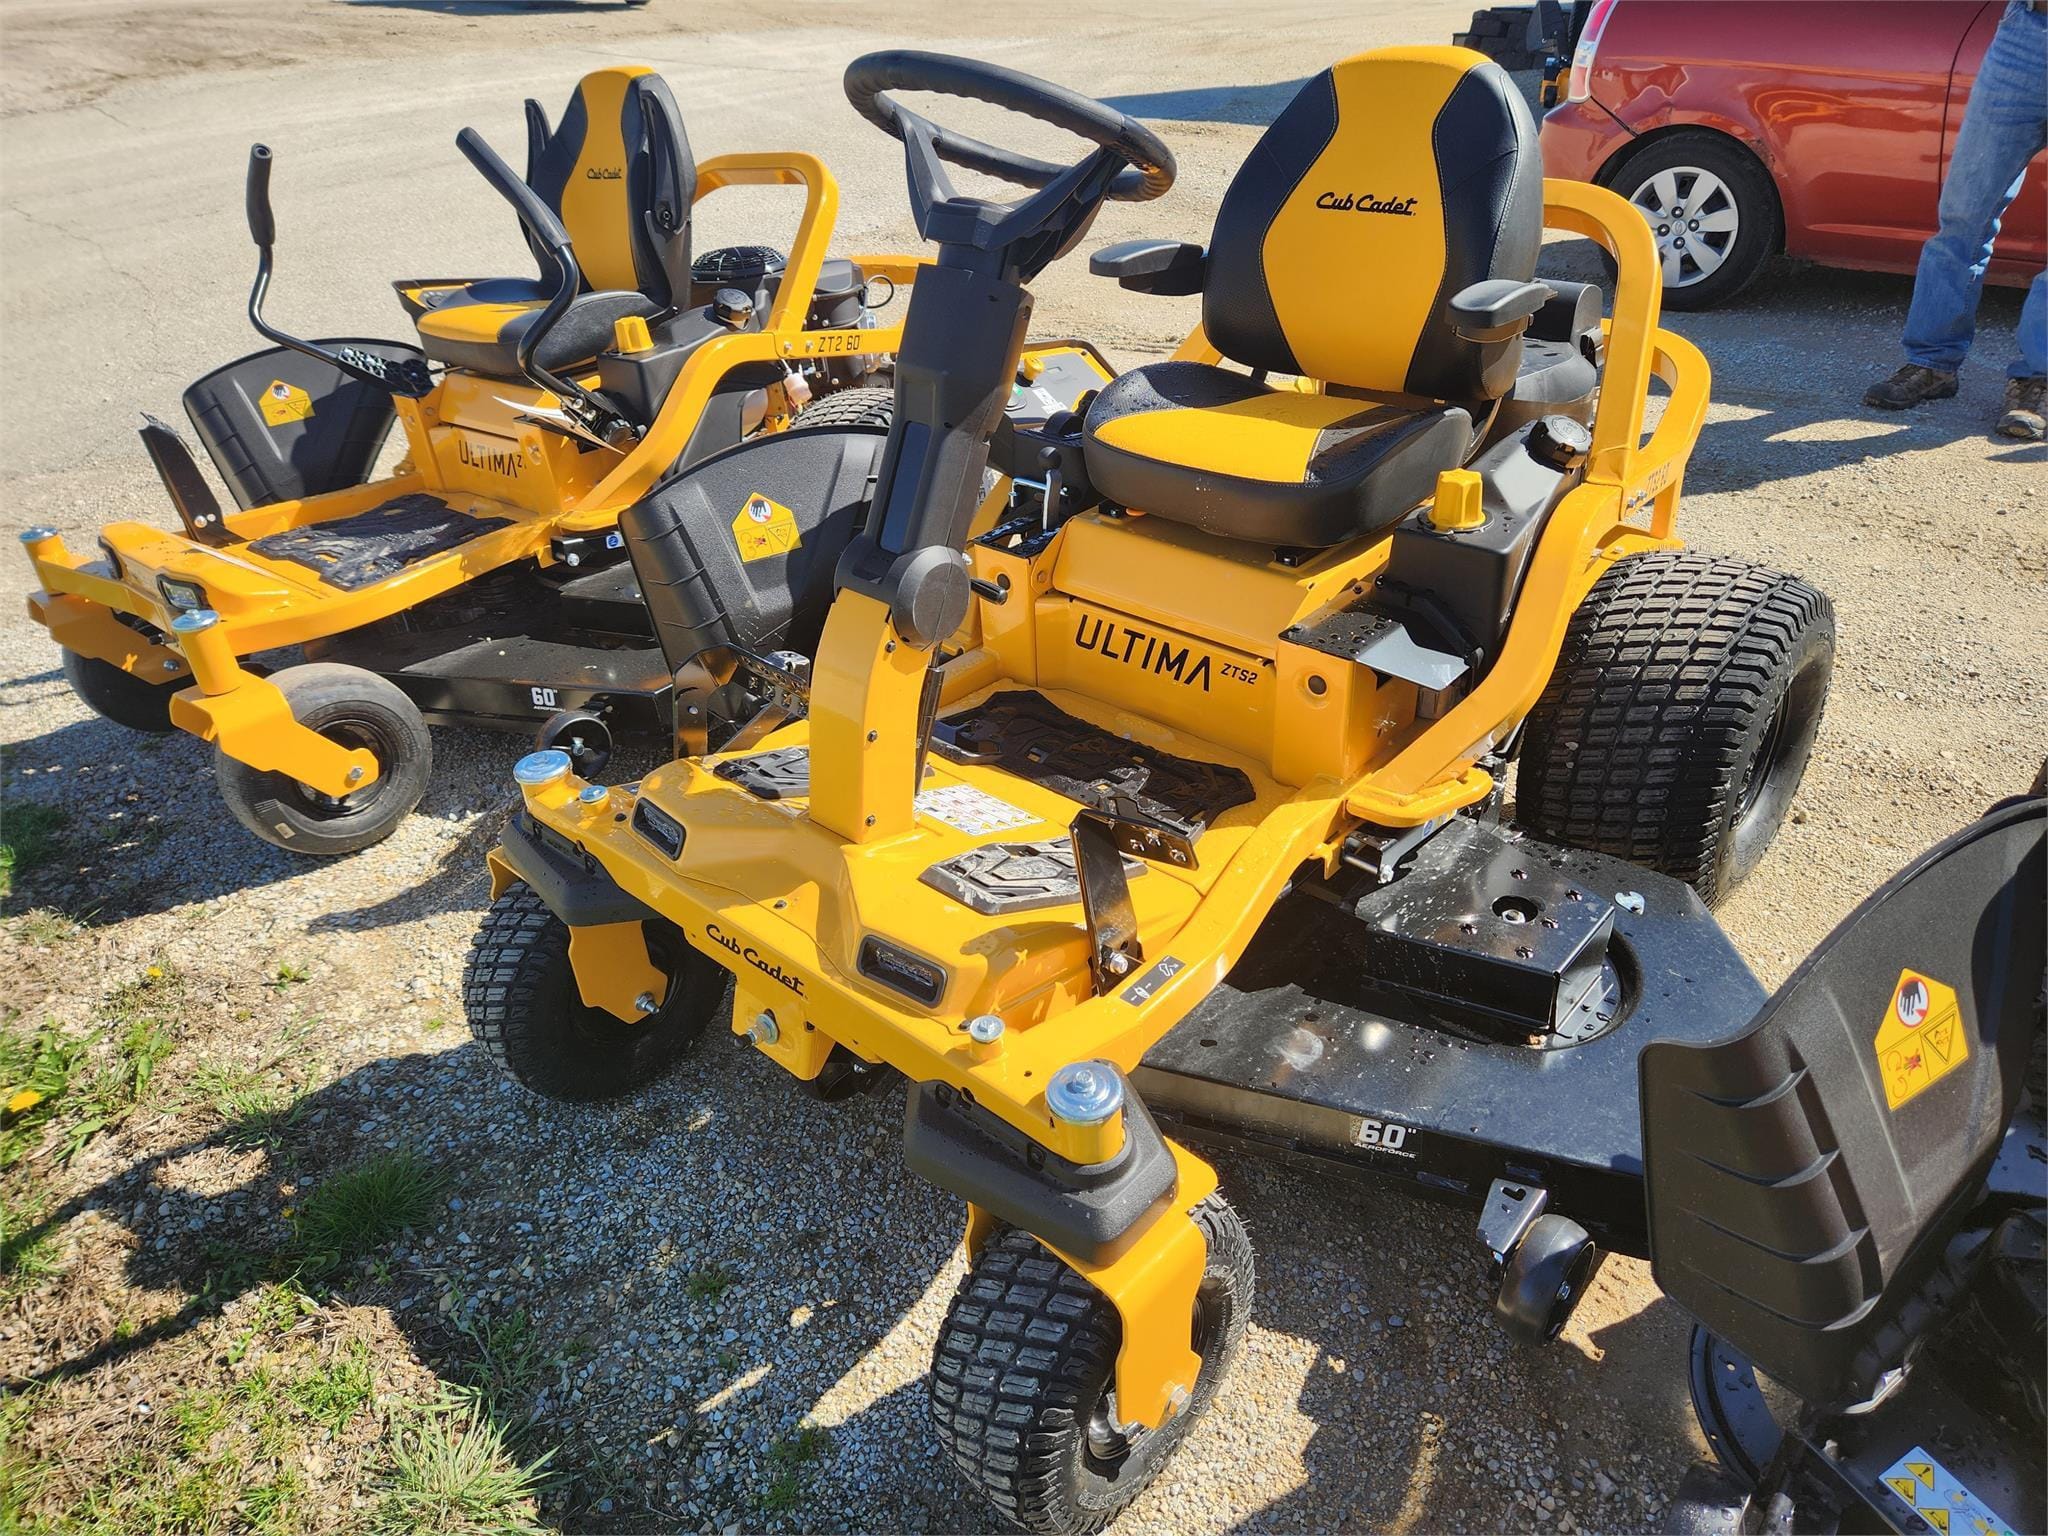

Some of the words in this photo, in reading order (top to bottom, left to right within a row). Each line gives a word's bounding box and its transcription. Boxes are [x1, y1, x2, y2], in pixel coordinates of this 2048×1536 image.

[1316, 191, 1354, 211] Cub
[1356, 194, 1417, 216] Cadet
[818, 335, 843, 353] ZT2
[846, 334, 861, 351] 60
[458, 439, 518, 479] ULTIMA
[1075, 614, 1211, 692] ULTIMA
[1220, 662, 1258, 685] ZTS2
[706, 924, 741, 955] Cub
[743, 947, 805, 997] Cadet
[1354, 1142, 1417, 1159] AEROFORCE
